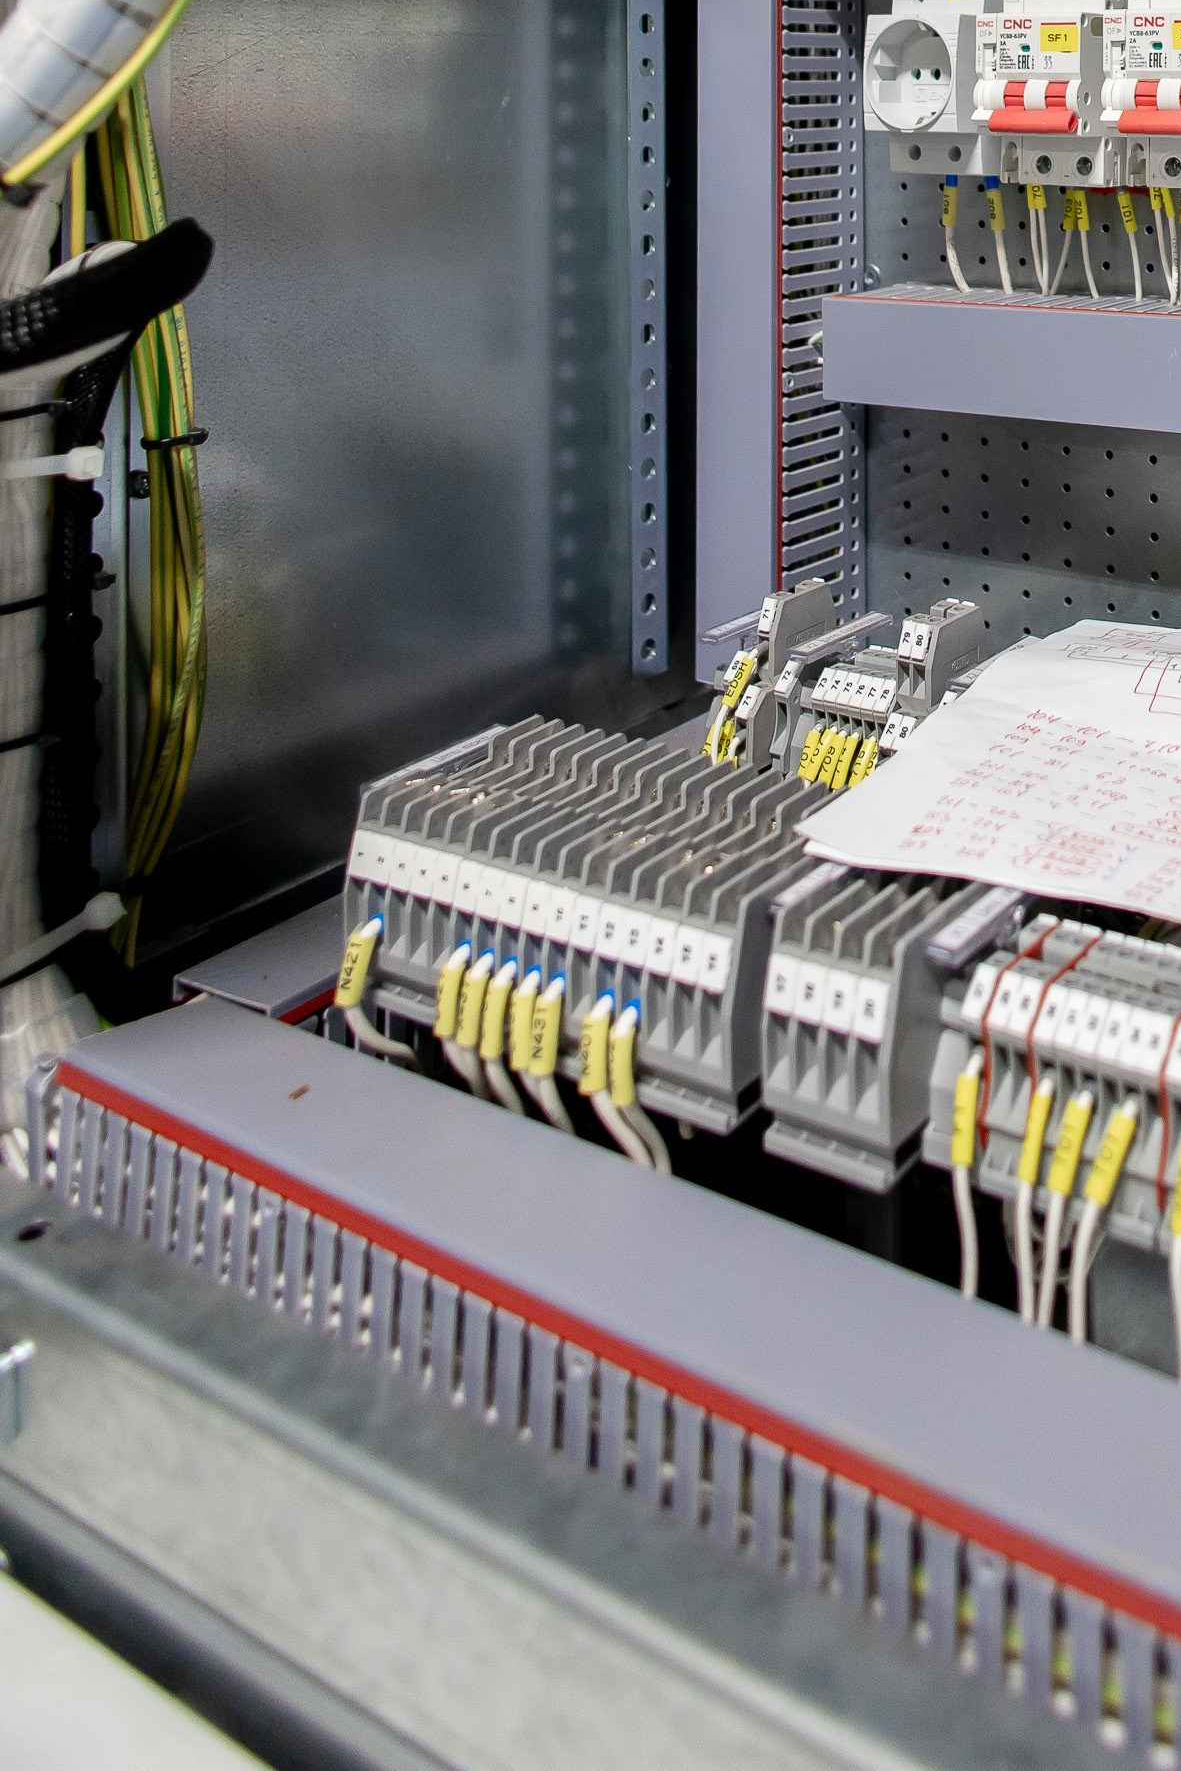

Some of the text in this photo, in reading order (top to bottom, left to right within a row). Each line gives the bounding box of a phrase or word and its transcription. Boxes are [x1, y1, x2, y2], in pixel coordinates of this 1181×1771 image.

[977, 20, 994, 28] CNC
[1003, 18, 1033, 30] CNC
[1103, 16, 1123, 25] CNC
[1133, 16, 1165, 28] CNC
[1047, 33, 1067, 43] SF1
[1129, 29, 1160, 38] YCB8-63PV
[1128, 37, 1137, 45] 2A
[1121, 204, 1133, 224] 101
[762, 608, 771, 620] 71
[902, 631, 911, 644] 79
[915, 633, 924, 647] 80
[725, 662, 749, 699] EDSH
[782, 669, 792, 682] 72
[817, 676, 828, 689] 73
[830, 678, 842, 691] 74
[842, 681, 853, 694] 75
[855, 683, 866, 696] 76
[867, 686, 878, 699] 77
[880, 688, 891, 701] 78
[742, 694, 753, 707] 71
[885, 722, 896, 736] 79
[898, 725, 909, 740] 80
[338, 941, 363, 991] N421
